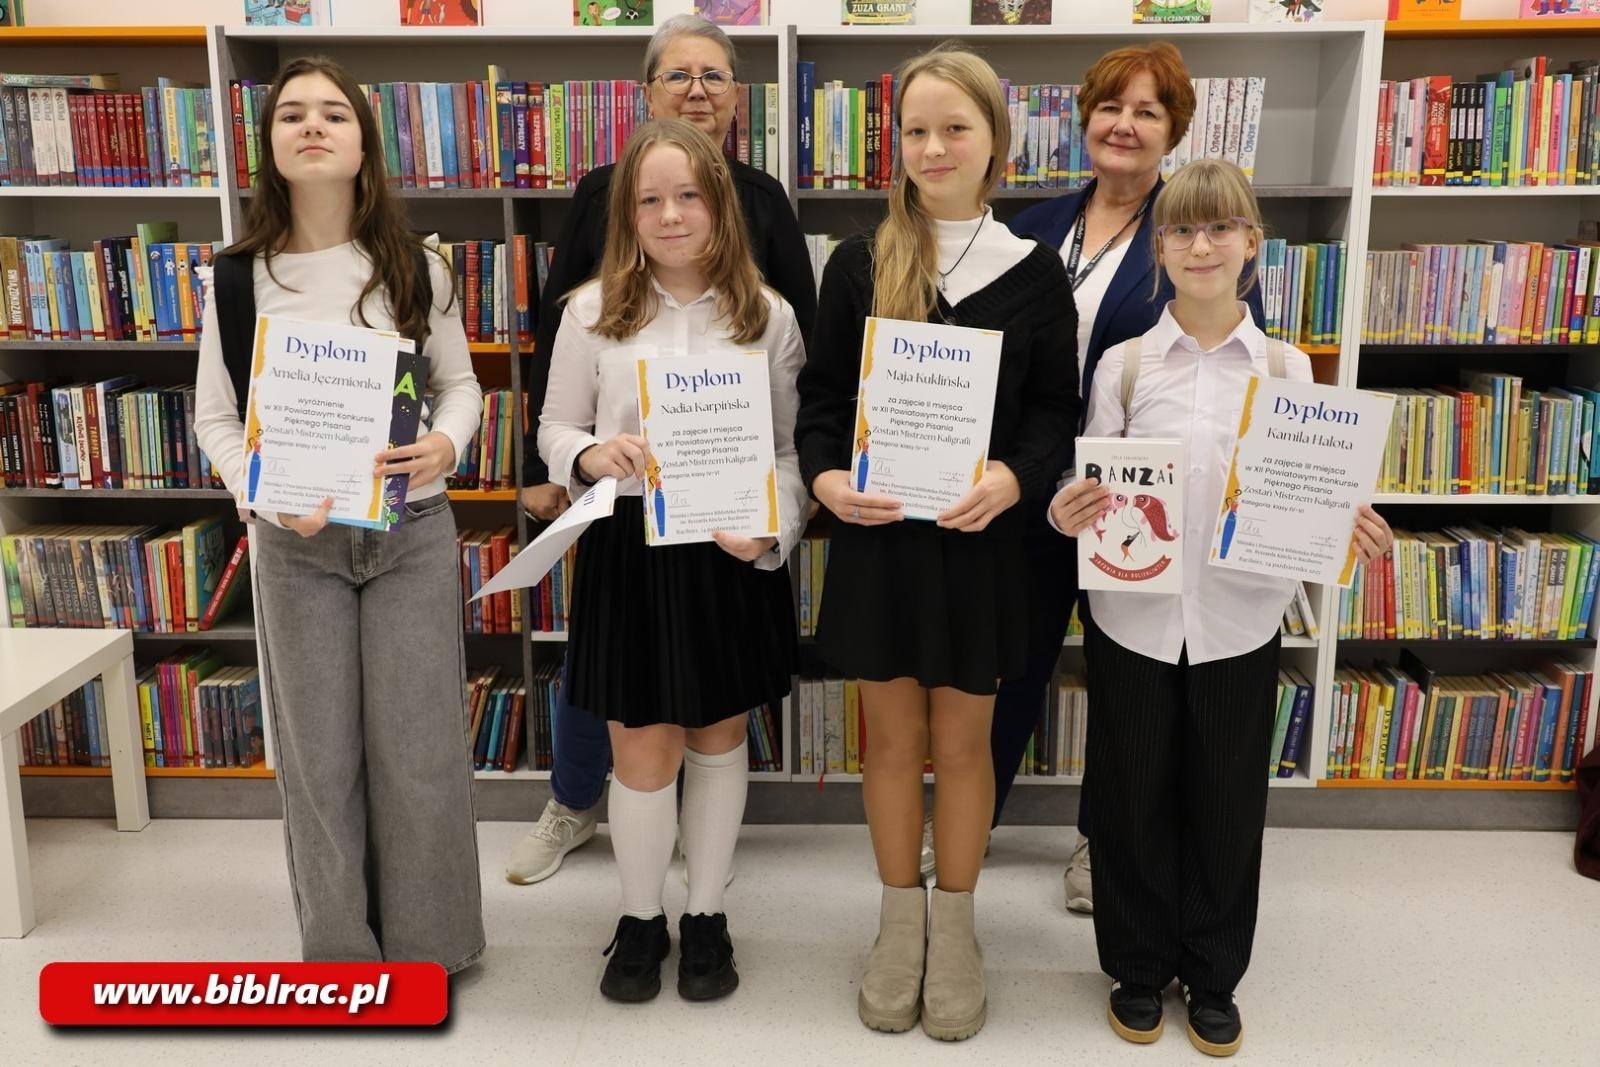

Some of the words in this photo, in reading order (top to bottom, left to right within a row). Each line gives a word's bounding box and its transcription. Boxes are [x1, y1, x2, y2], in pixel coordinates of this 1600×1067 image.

[853, 3, 874, 12] ZUZA
[876, 3, 906, 12] GRANT
[286, 336, 366, 362] Dyplom
[893, 337, 970, 362] Dyplom
[269, 367, 310, 382] Amelia
[312, 370, 382, 391] Jęczmionka
[394, 372, 417, 400] A
[666, 369, 741, 392] Dyplom
[886, 369, 914, 384] Maja
[916, 371, 970, 389] Kuklińska
[298, 396, 345, 409] wyróżnienie
[661, 402, 693, 414] Nadia
[695, 398, 750, 414] Karpińska
[898, 398, 925, 409] zajęcie
[932, 401, 962, 412] miejsca
[1274, 396, 1359, 426] Dyplom
[284, 406, 335, 419] Powiatowym
[337, 412, 375, 423] Konkursie
[284, 416, 321, 428] Pięknego
[323, 421, 351, 431] Pisania
[890, 407, 938, 420] Powiatowym
[940, 412, 977, 424] Konkursie
[682, 428, 708, 438] zajęcie
[713, 425, 742, 435] miejsca
[890, 418, 925, 429] Pięknego
[926, 422, 953, 432] Pisania
[264, 424, 294, 436] Zostań
[296, 427, 333, 441] Mistrzem
[335, 432, 370, 446] Kaligrafii
[675, 437, 722, 448] Powiatowym
[724, 434, 759, 443] Konkursie
[872, 426, 899, 436] Zostań
[901, 428, 936, 442] Mistrzem
[938, 433, 971, 446] Kaligrafii
[1267, 427, 1310, 444] Kamila
[1312, 433, 1353, 450] Halota
[677, 448, 710, 457] Pięknego
[712, 446, 739, 454] Pisania
[662, 458, 688, 468] Zostań
[689, 455, 725, 466] Mistrzem
[726, 454, 758, 466] Kaligrafii
[1263, 456, 1272, 464] za
[1274, 458, 1303, 471] zajęcie
[1313, 464, 1346, 476] miejsca
[1264, 478, 1301, 491] Pięknego
[1303, 484, 1332, 495] Pisania
[1265, 467, 1317, 482] Powiatowym
[1319, 476, 1359, 488] Konkursie
[1242, 485, 1272, 497] Zostań
[1274, 489, 1313, 504] Mistrzem
[1314, 496, 1350, 510] Kaligrafii
